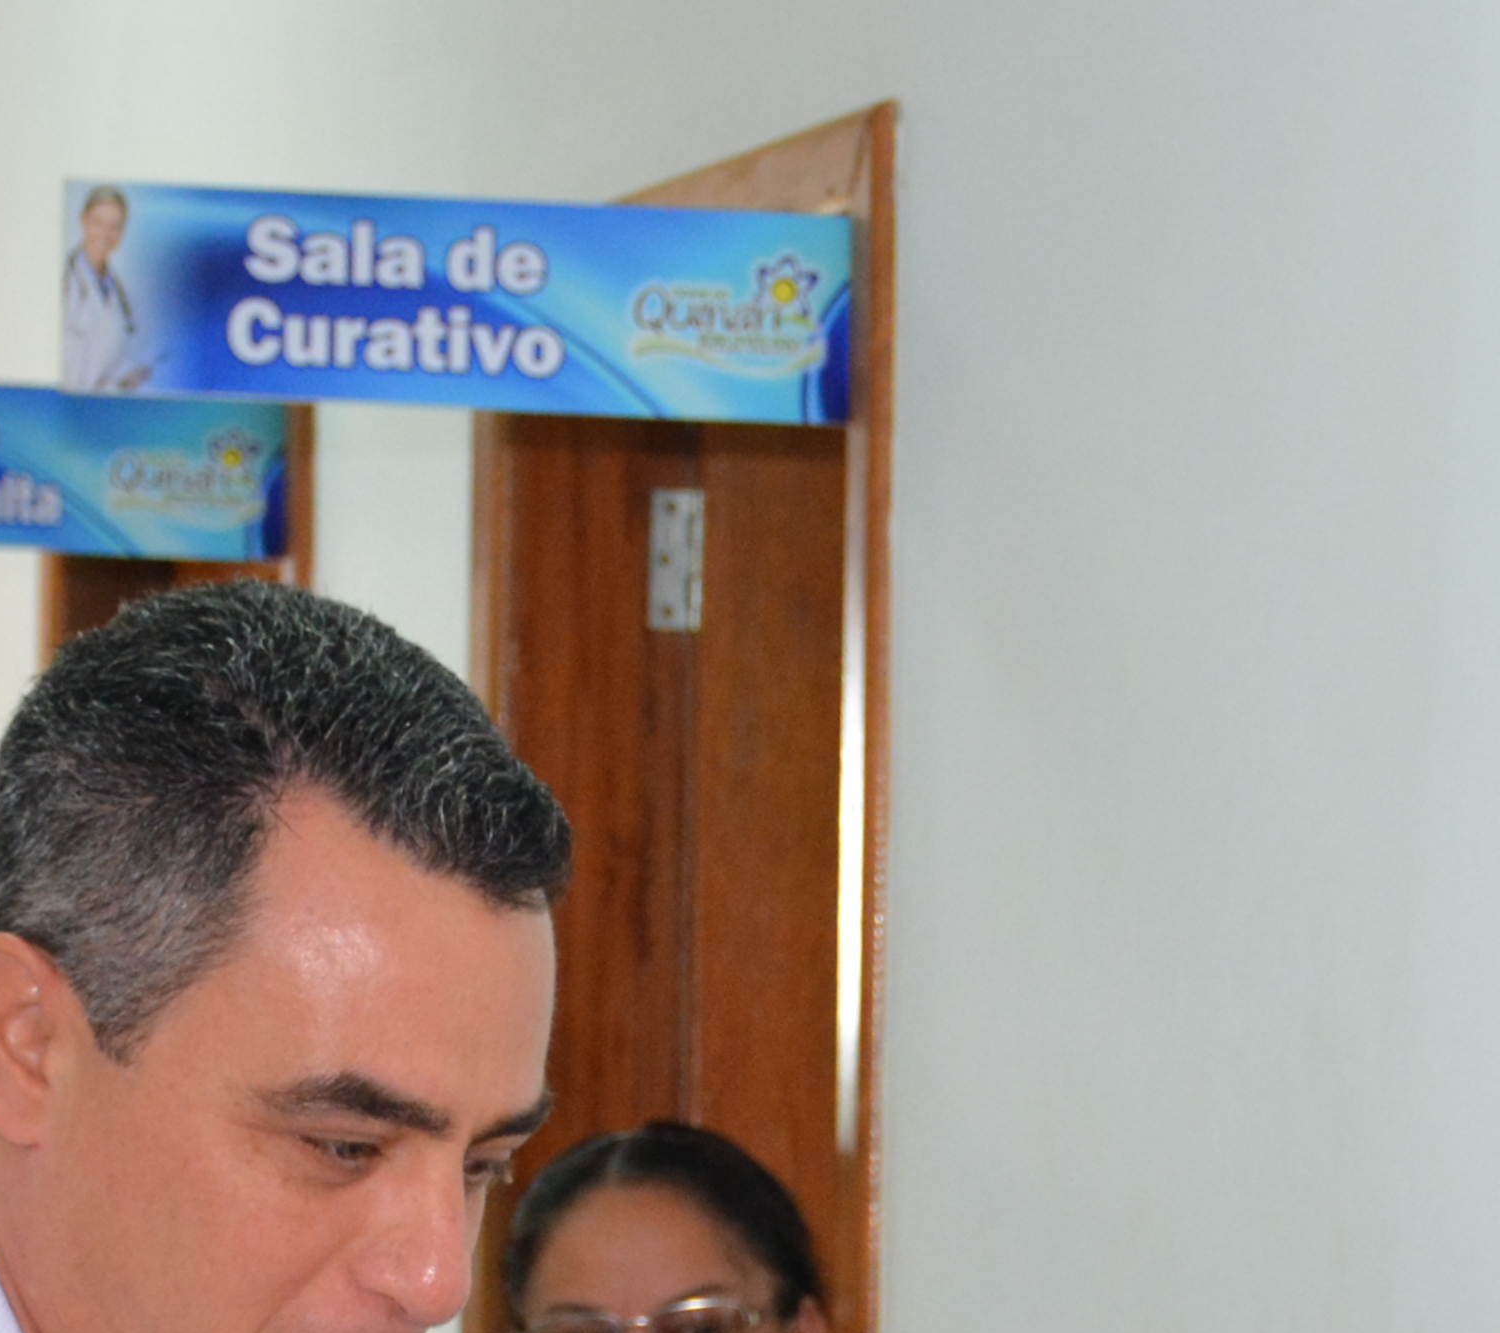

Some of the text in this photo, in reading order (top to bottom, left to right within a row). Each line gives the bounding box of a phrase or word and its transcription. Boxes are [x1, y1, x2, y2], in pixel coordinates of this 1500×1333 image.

[245, 216, 549, 296] Sala de
[227, 297, 565, 380] Curativo
